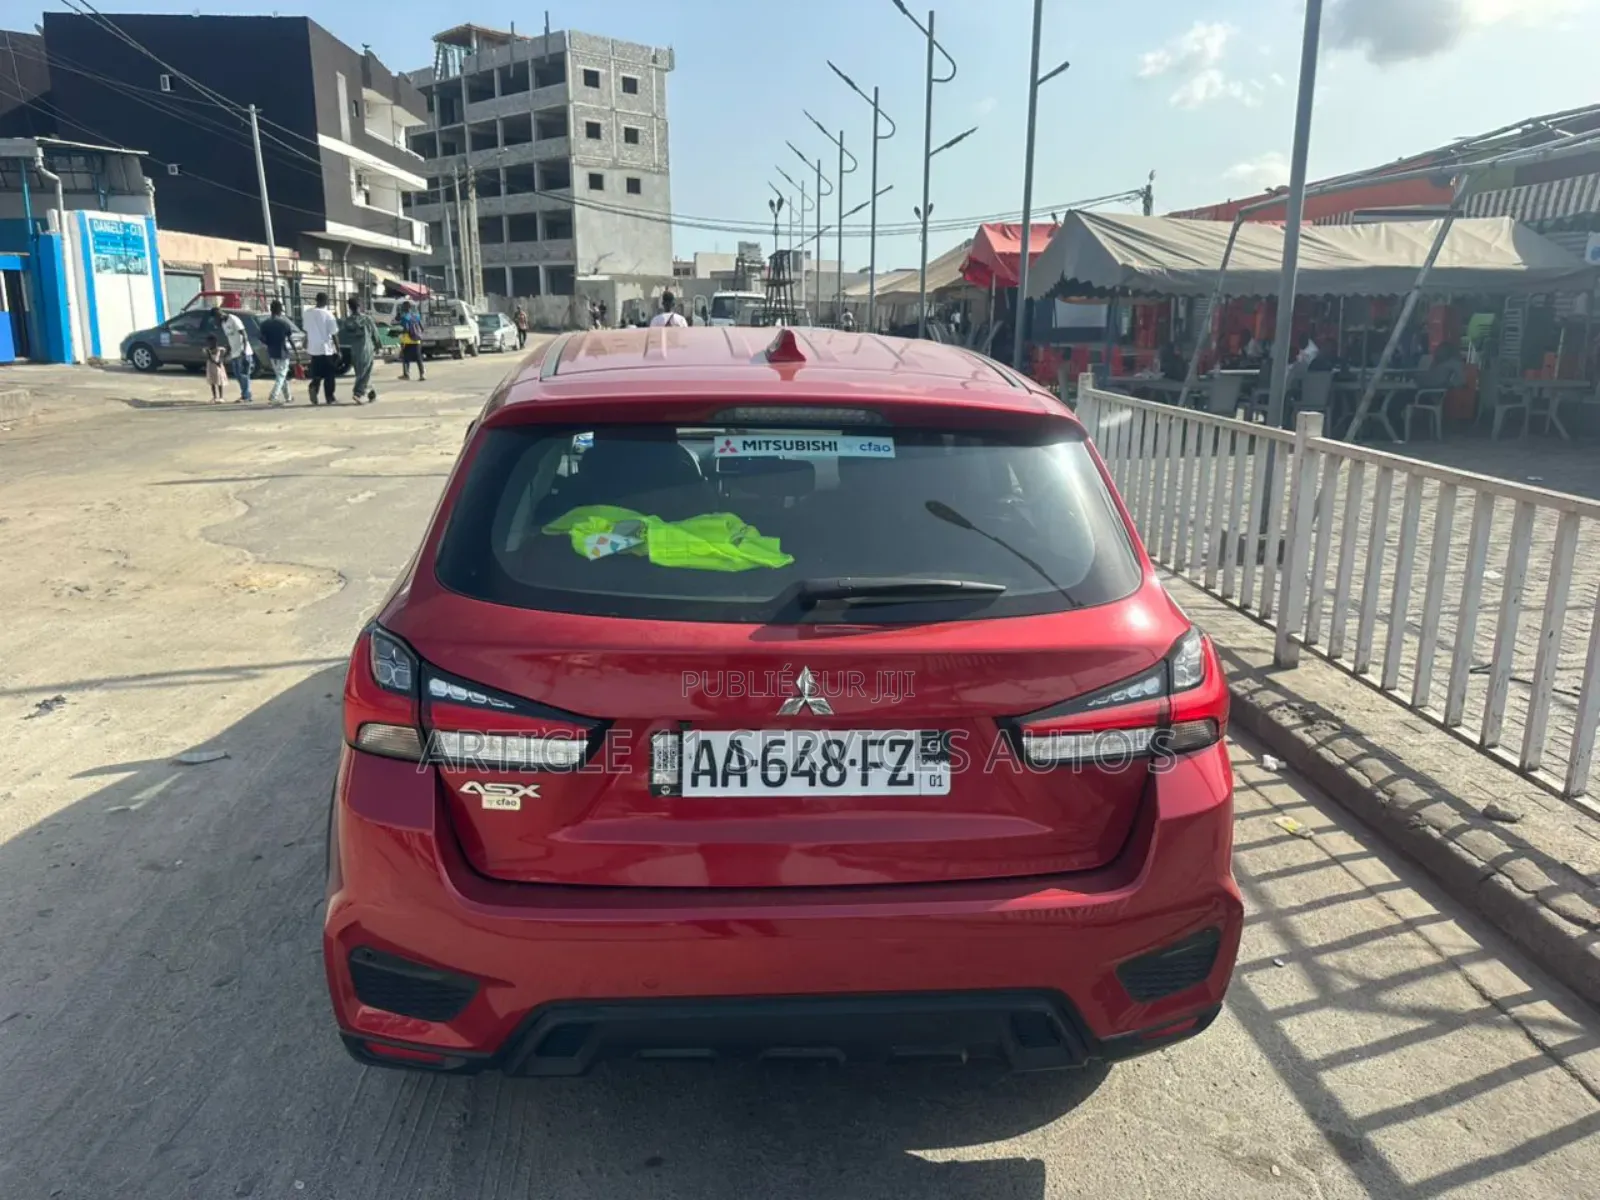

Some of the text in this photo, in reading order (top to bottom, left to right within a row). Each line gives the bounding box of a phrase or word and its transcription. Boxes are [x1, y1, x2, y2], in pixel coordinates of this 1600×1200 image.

[742, 440, 891, 453] MITSUBISHI cfao
[929, 774, 944, 787] 01
[459, 781, 541, 798] ASX
[496, 798, 517, 807] cfao
